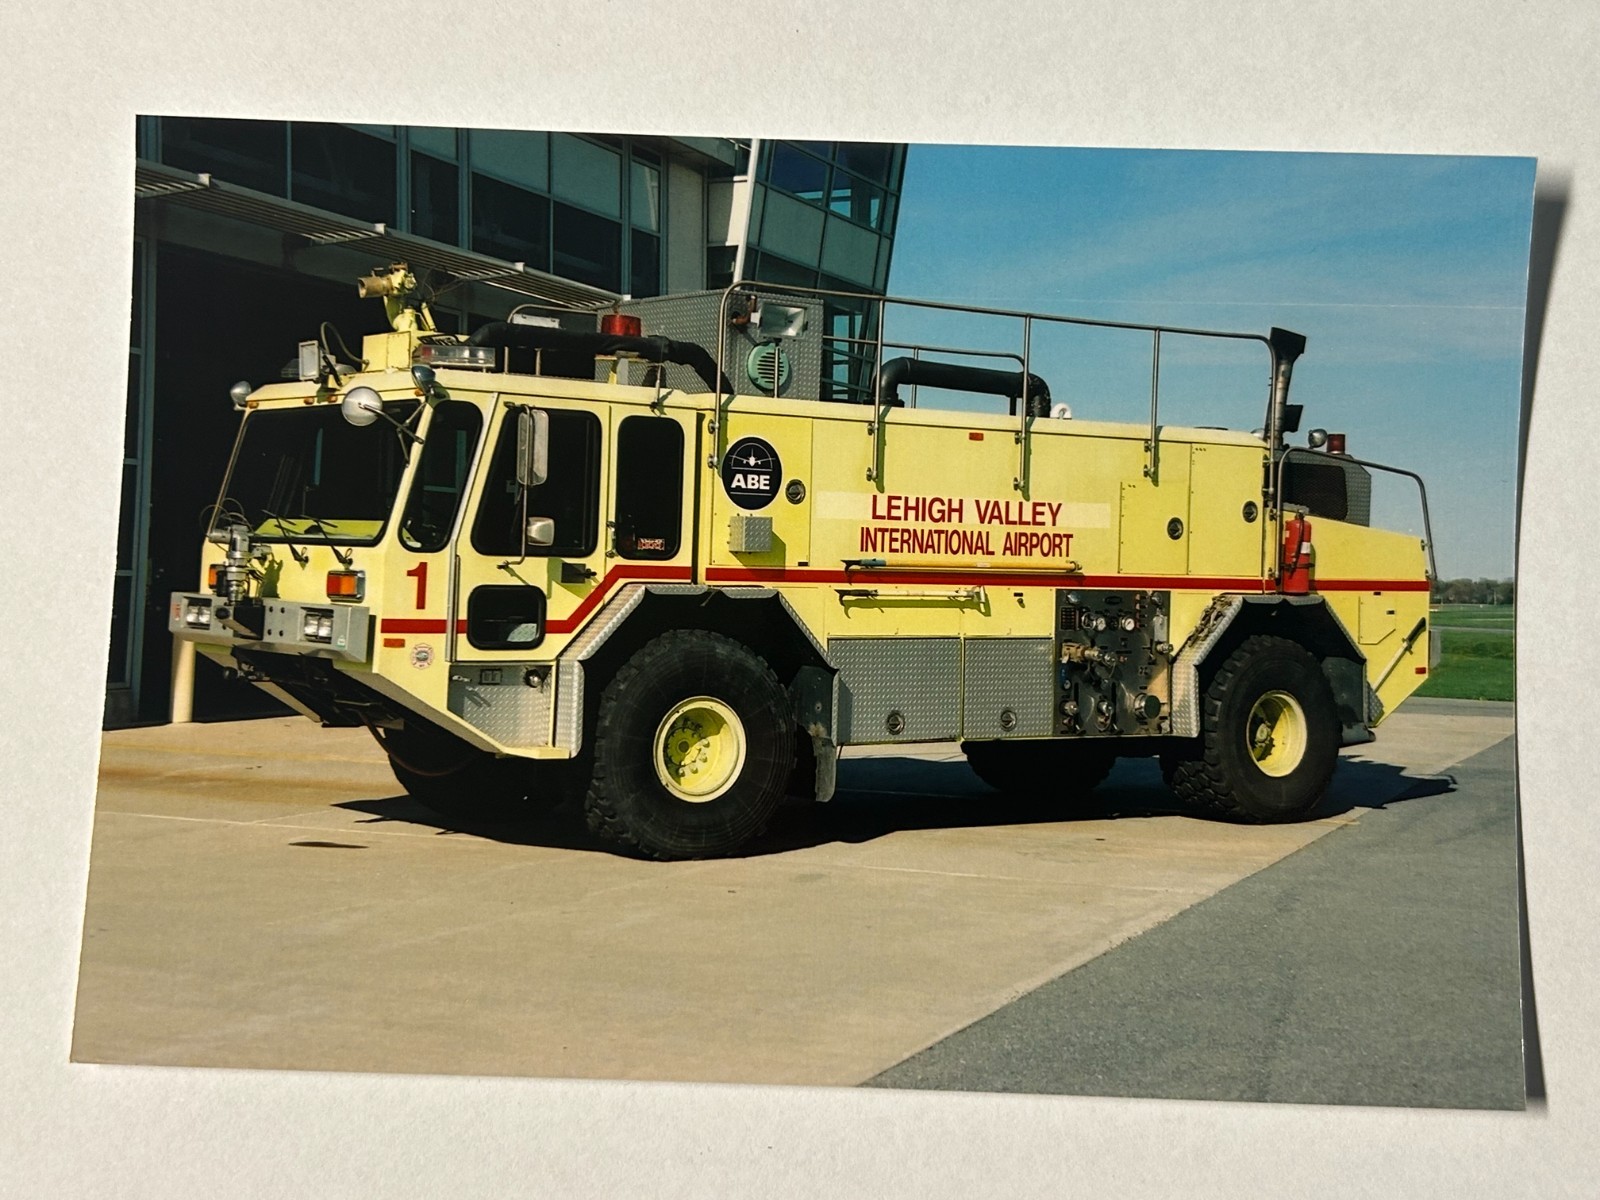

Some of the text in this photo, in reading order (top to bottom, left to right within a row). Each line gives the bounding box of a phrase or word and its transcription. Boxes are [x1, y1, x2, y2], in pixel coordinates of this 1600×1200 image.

[731, 473, 770, 490] ABE
[871, 494, 1062, 527] LEHIGH VALLEY
[860, 527, 1073, 557] INTERNATIONAL AIRPORT
[407, 562, 428, 610] 1
